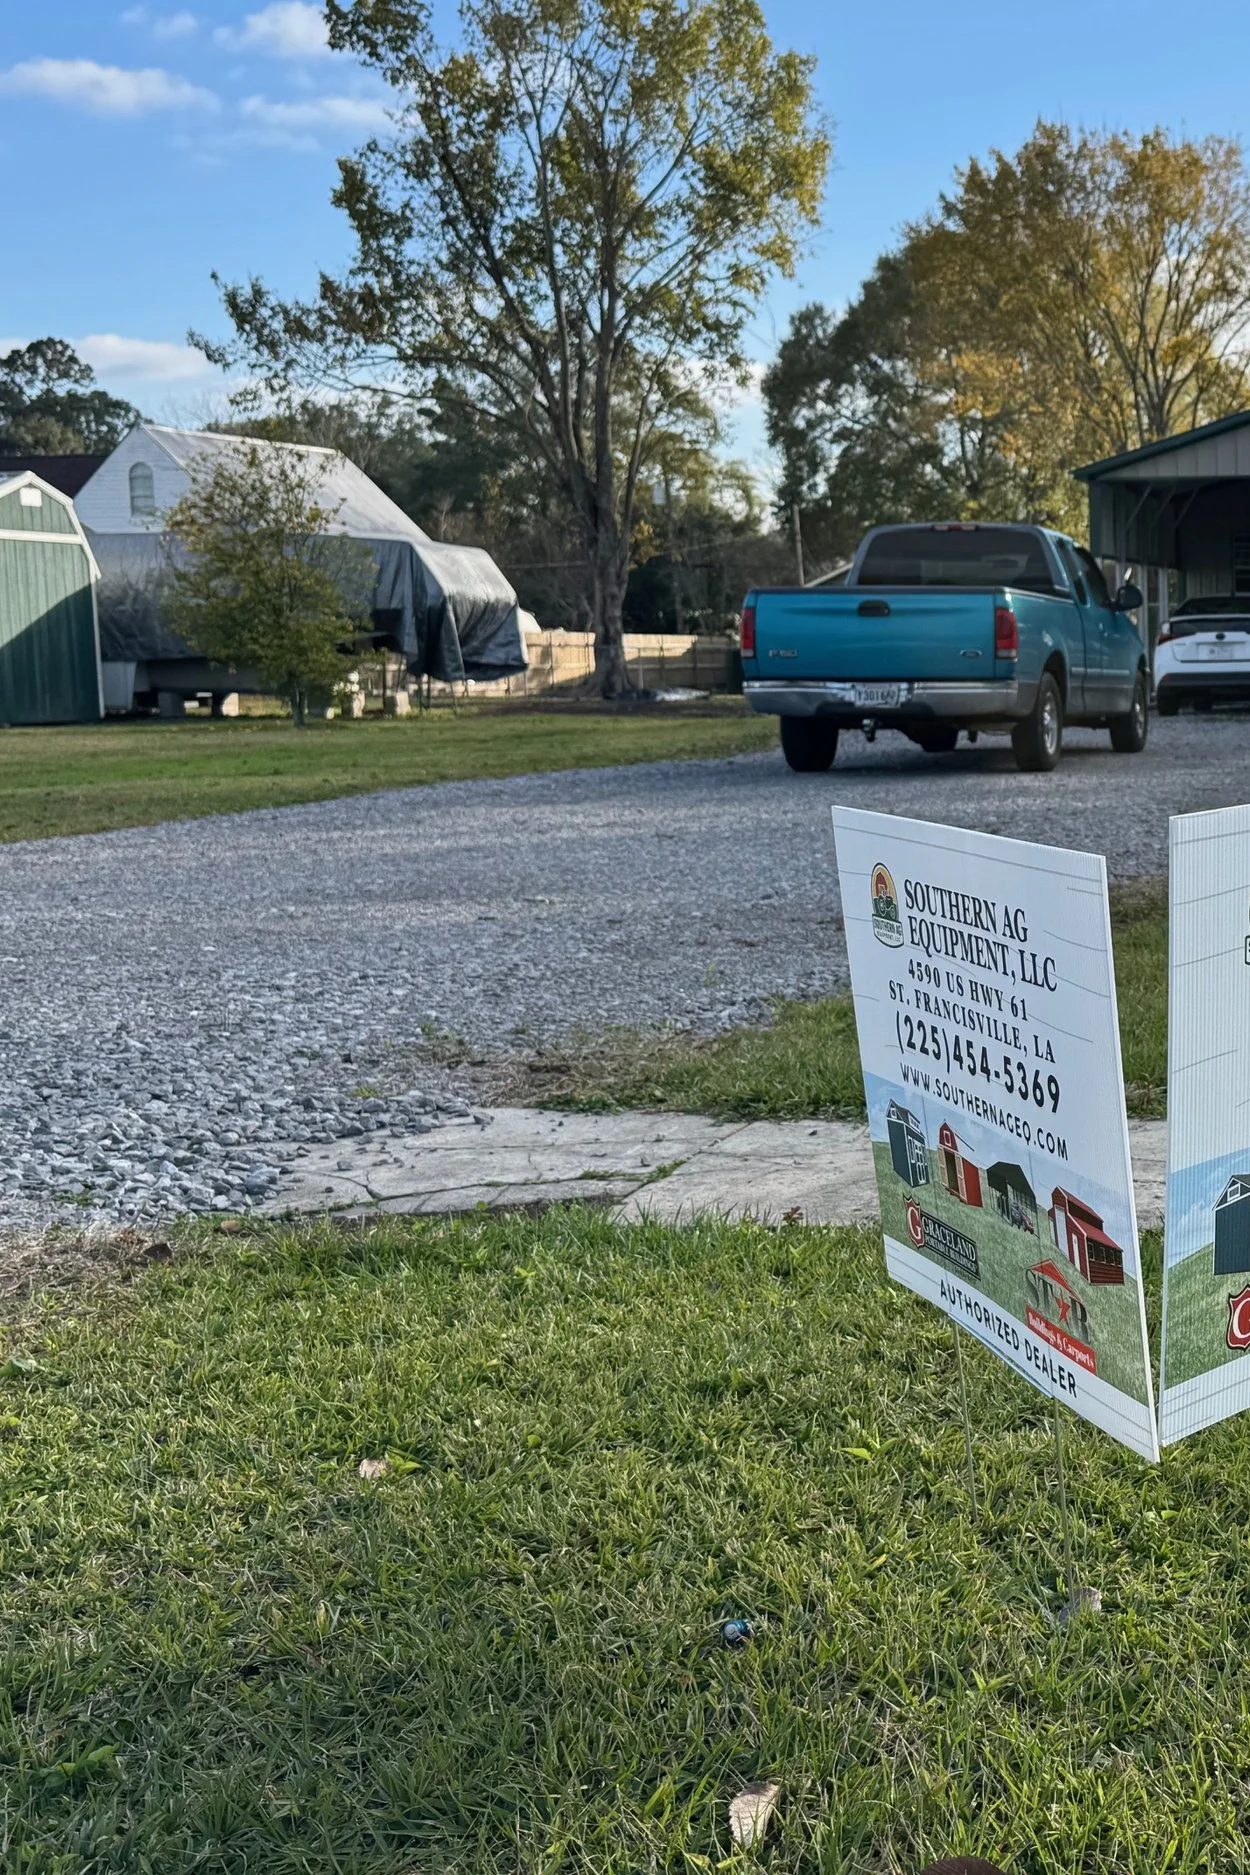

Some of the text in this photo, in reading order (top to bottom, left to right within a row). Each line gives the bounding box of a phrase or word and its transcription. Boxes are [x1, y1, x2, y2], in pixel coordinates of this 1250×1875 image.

[904, 879, 1028, 942] SOUTHERN AG
[908, 915, 1058, 992] EQUIPMENT, LLC
[908, 959, 1028, 1022] 4590 US HWY 61
[889, 980, 1056, 1064] ST. FRANCISVILLE, LA
[896, 1010, 1060, 1113] (225)454-5369
[900, 1062, 1068, 1161] WWW.SOUTHERNAGEQ.COM
[922, 1216, 976, 1262] GRACELAND
[940, 1279, 1077, 1398] AUTHORIZED DEALER
